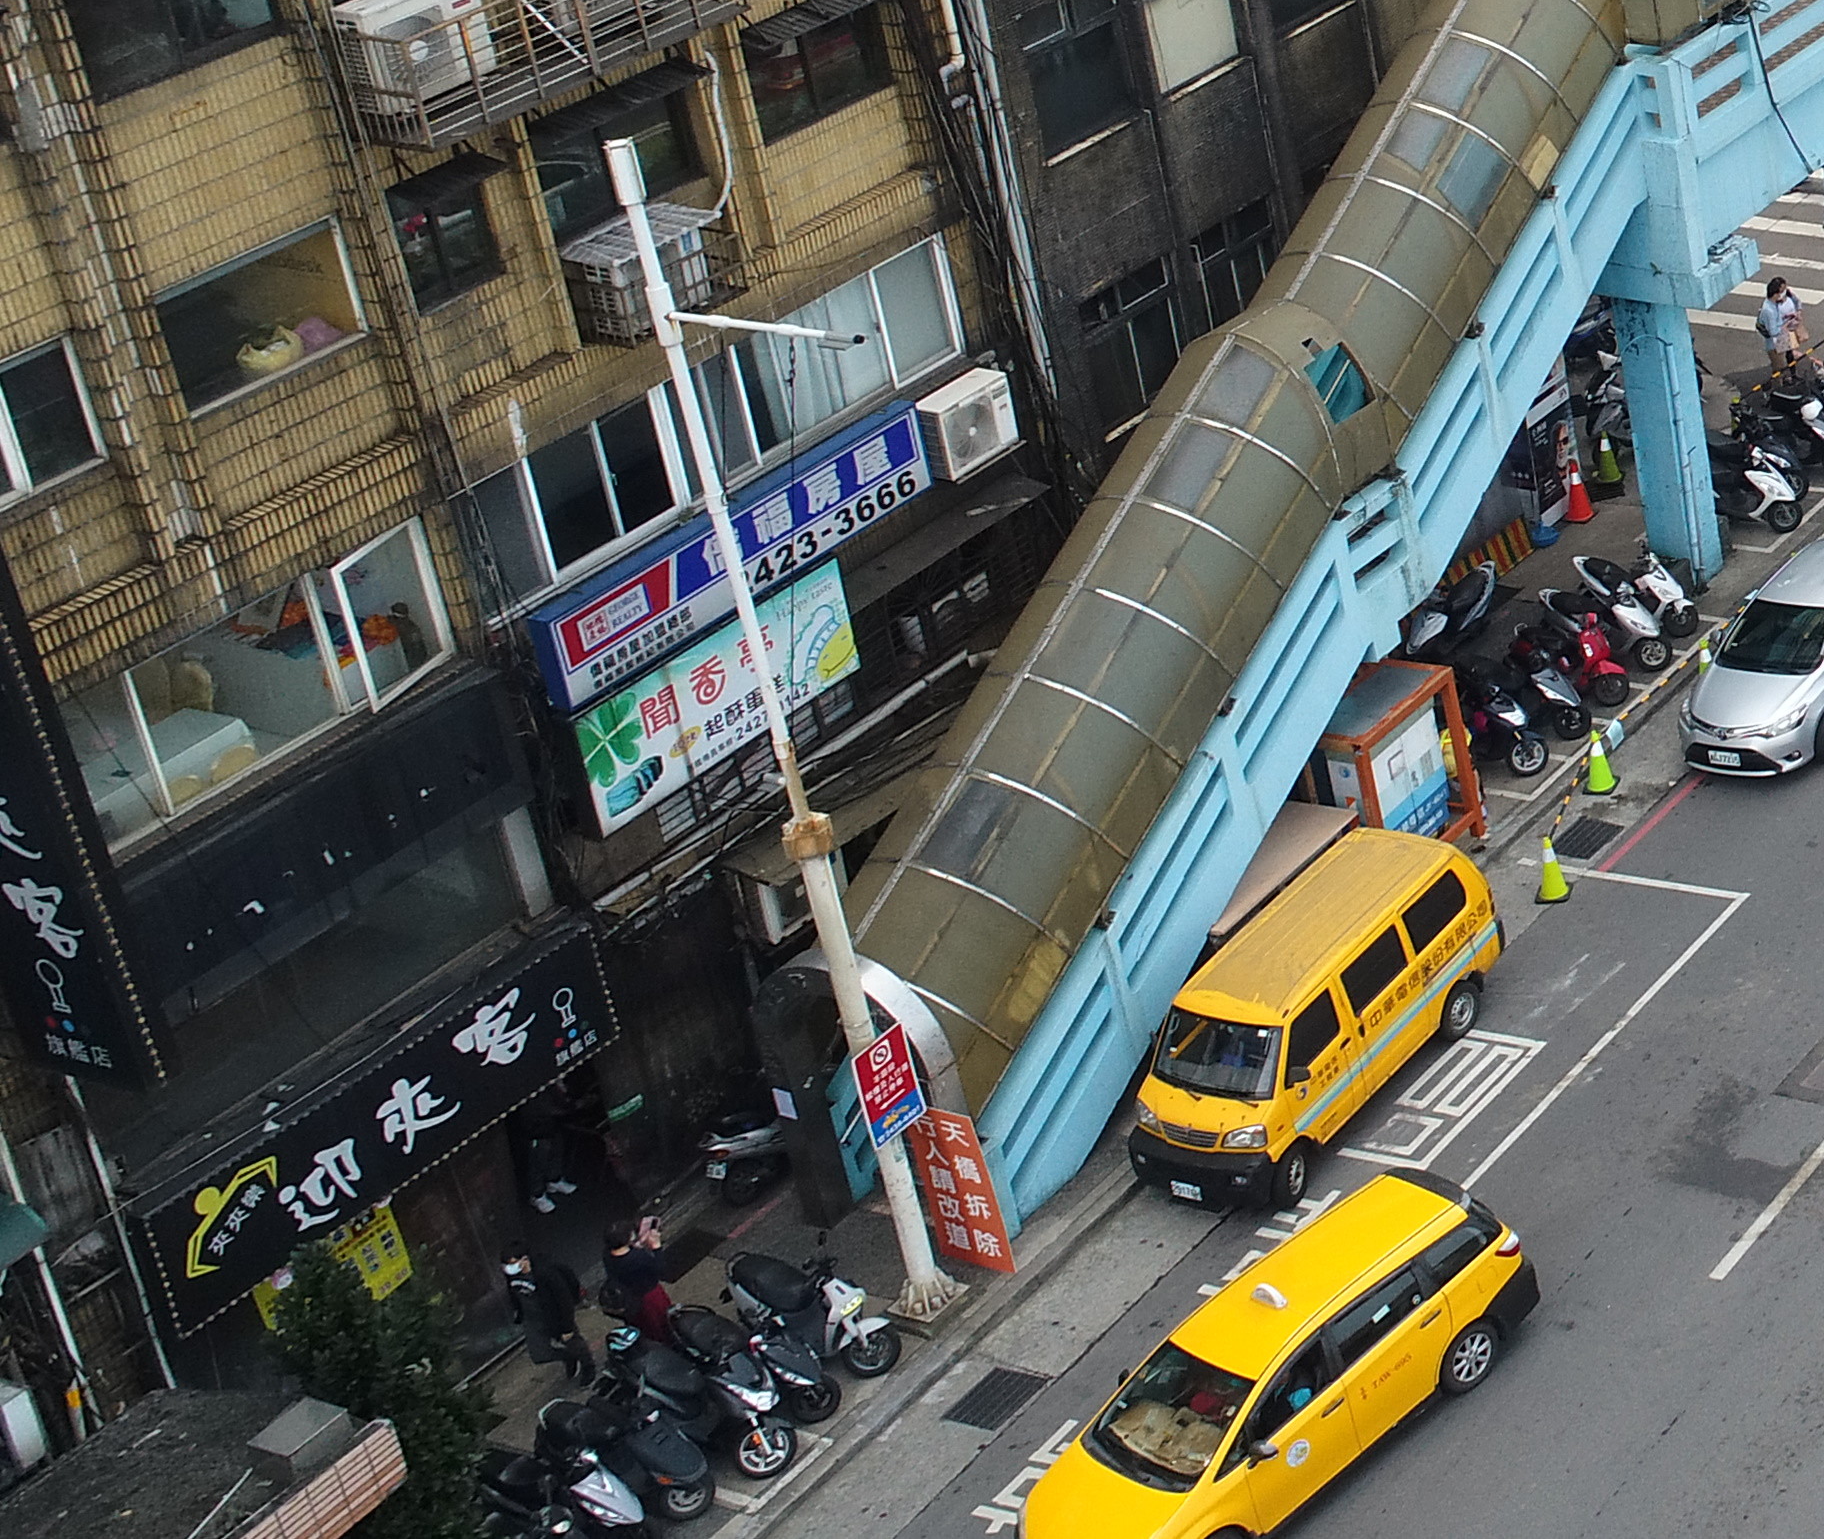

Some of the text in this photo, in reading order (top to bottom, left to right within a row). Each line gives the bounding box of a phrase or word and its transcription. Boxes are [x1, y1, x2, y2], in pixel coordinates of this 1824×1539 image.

[1369, 899, 1488, 1028] 中華電信股份有限公司
[278, 987, 536, 1231] 迎夾客
[208, 1183, 265, 1256] 夾夾樂
[913, 1115, 972, 1250] 行人請改道
[940, 1119, 1002, 1258] 天橋拆除
